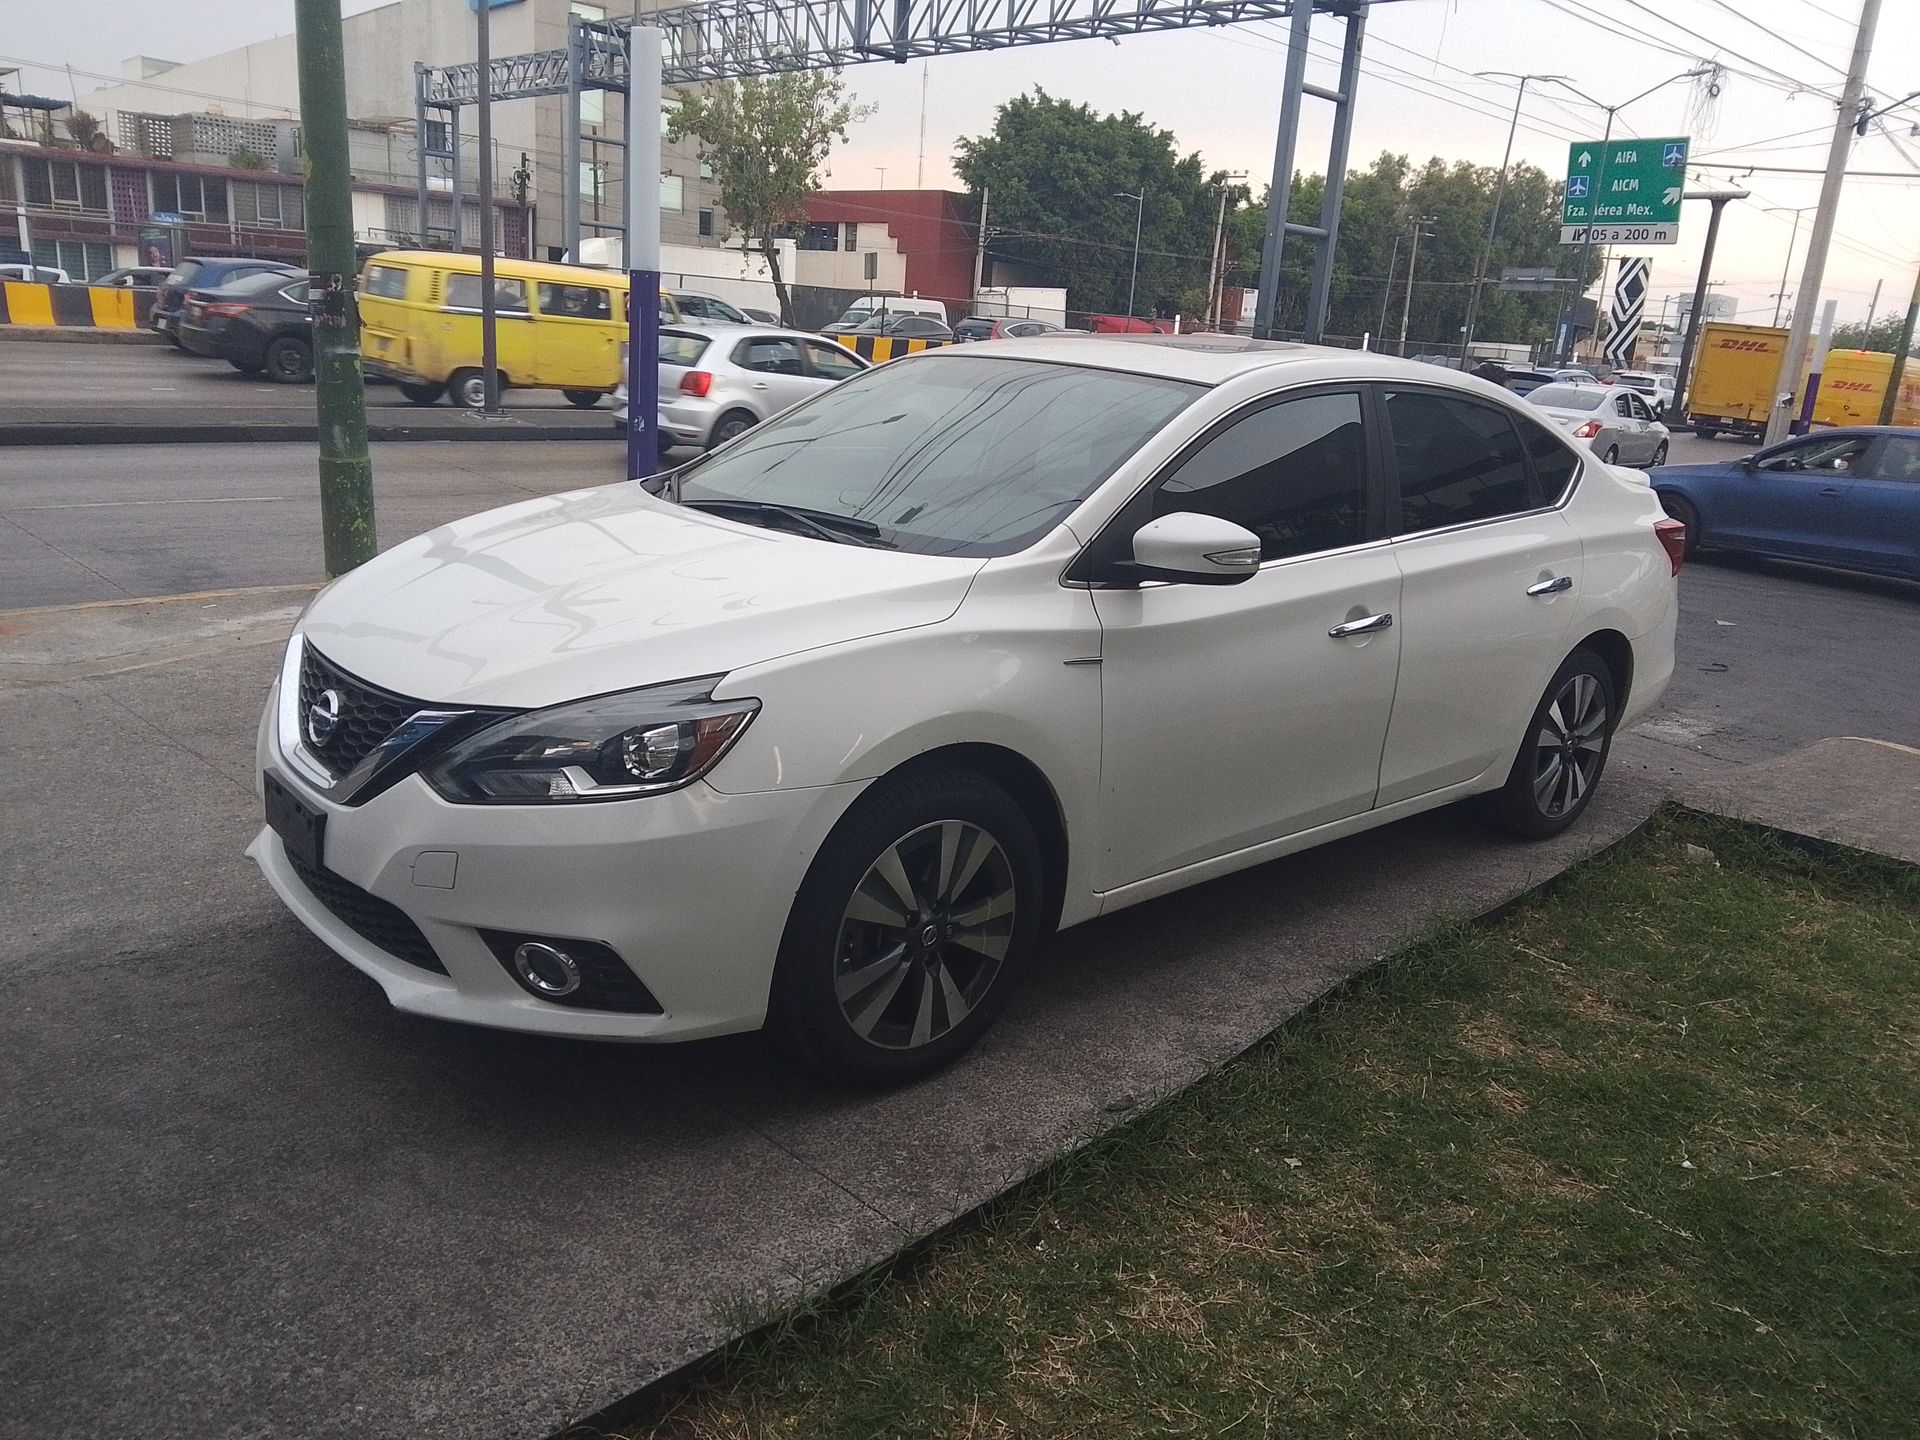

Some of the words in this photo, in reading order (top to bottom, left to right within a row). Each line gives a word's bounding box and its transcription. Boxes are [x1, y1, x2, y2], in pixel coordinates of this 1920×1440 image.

[1615, 151, 1637, 163] AIFA
[1611, 179, 1639, 191] AICM
[1567, 204, 1588, 217] Fza.
[1626, 203, 1654, 216] Mex.
[1611, 230, 1620, 240] a
[1624, 228, 1649, 240] 200
[1654, 230, 1667, 240] m
[1719, 338, 1770, 353] DHL
[1831, 380, 1873, 393] DHL
